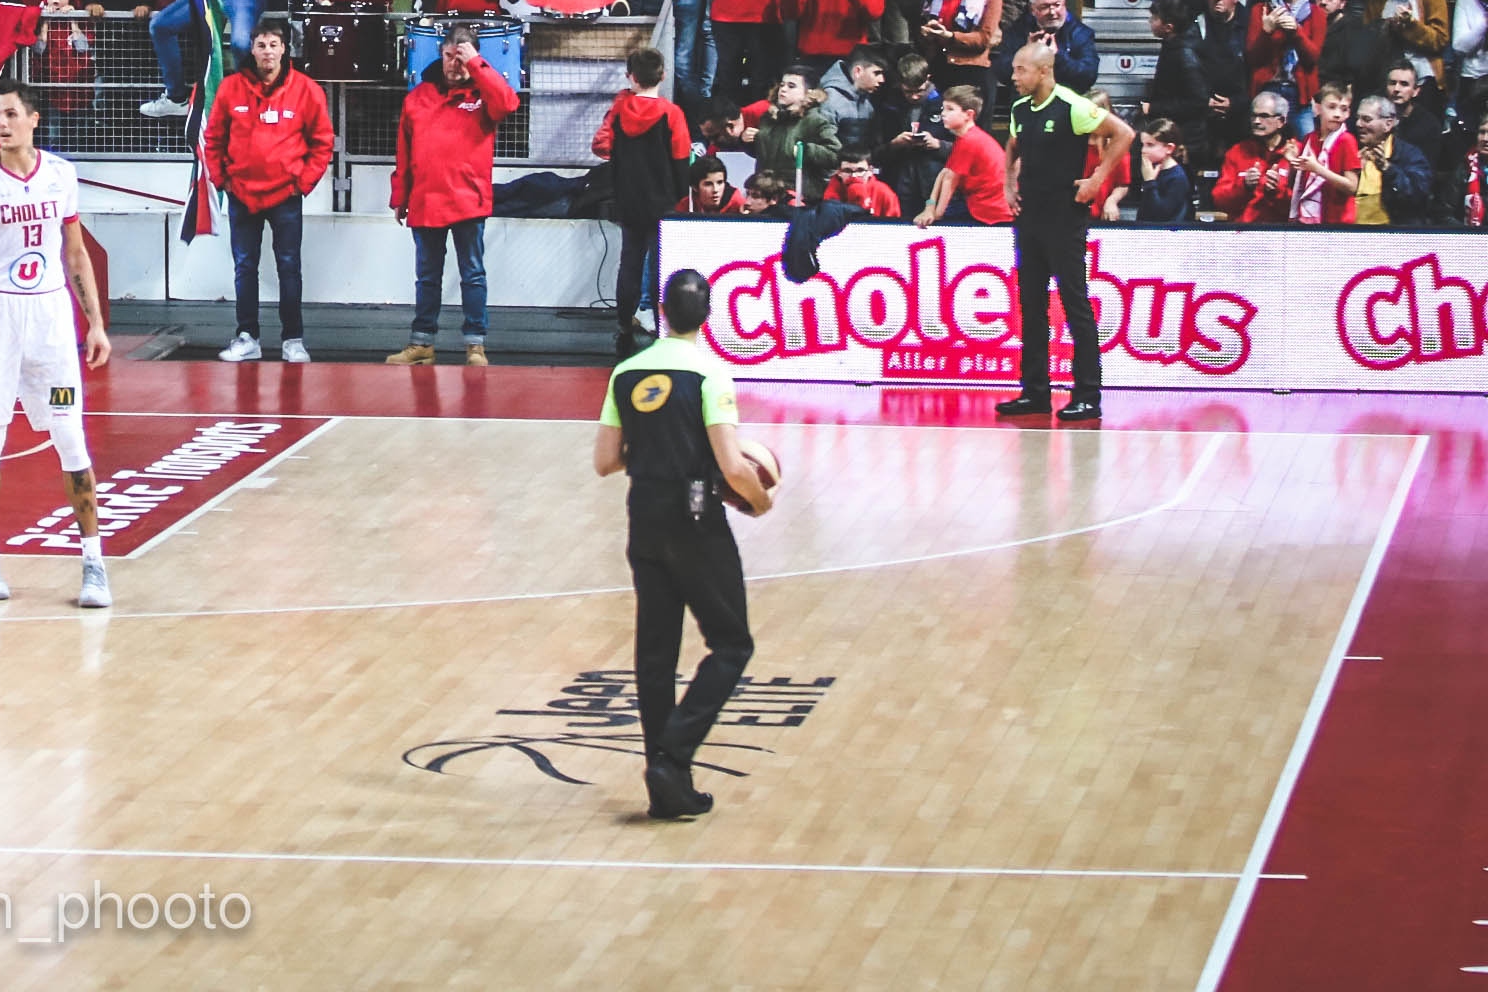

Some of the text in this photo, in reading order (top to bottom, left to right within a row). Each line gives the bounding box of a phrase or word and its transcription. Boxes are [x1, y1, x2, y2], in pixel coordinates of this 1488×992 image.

[0, 200, 59, 225] CHOLET
[22, 224, 43, 248] 13
[18, 261, 38, 281] U
[1336, 252, 1488, 371] Ch
